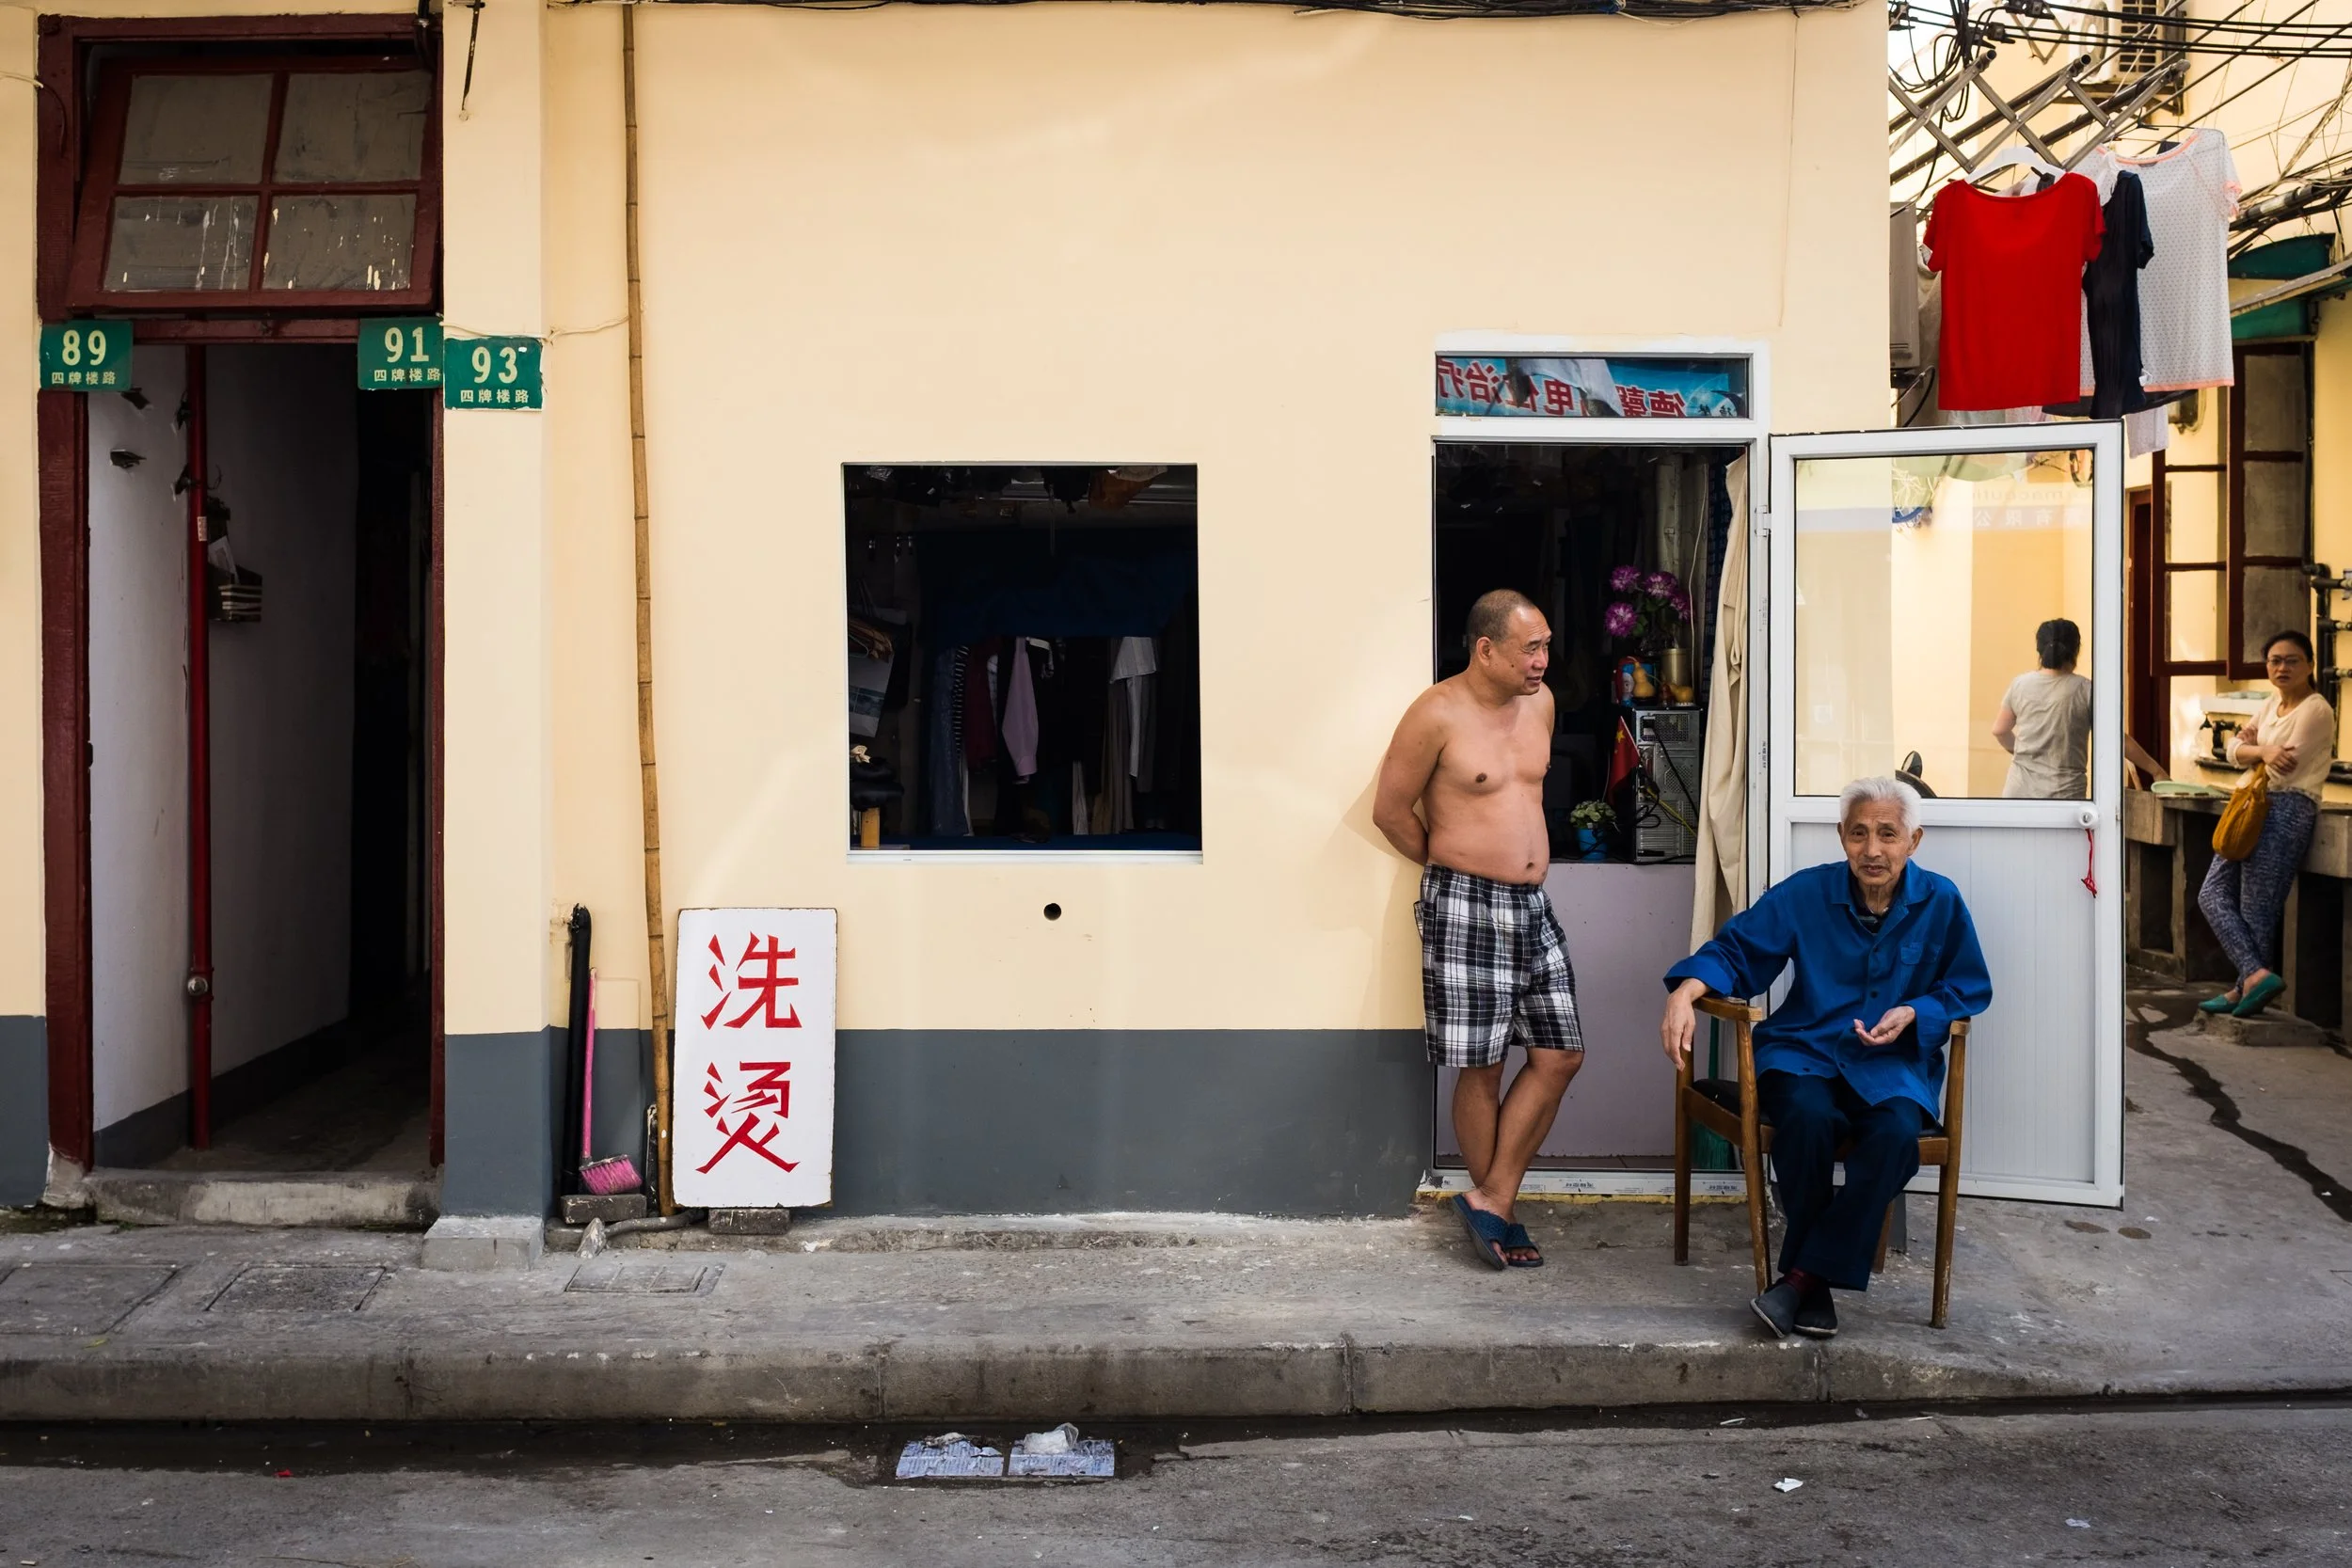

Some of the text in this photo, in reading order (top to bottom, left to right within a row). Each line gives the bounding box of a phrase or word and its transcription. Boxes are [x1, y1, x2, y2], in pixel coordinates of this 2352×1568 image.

[61, 329, 106, 366] 89
[384, 326, 430, 363] 91
[52, 372, 116, 385] 四牌楼路
[373, 368, 441, 382] 四牌楼路
[471, 346, 517, 384] 93
[460, 388, 530, 404] 四牌楼路
[695, 931, 803, 1174] 洗烫
